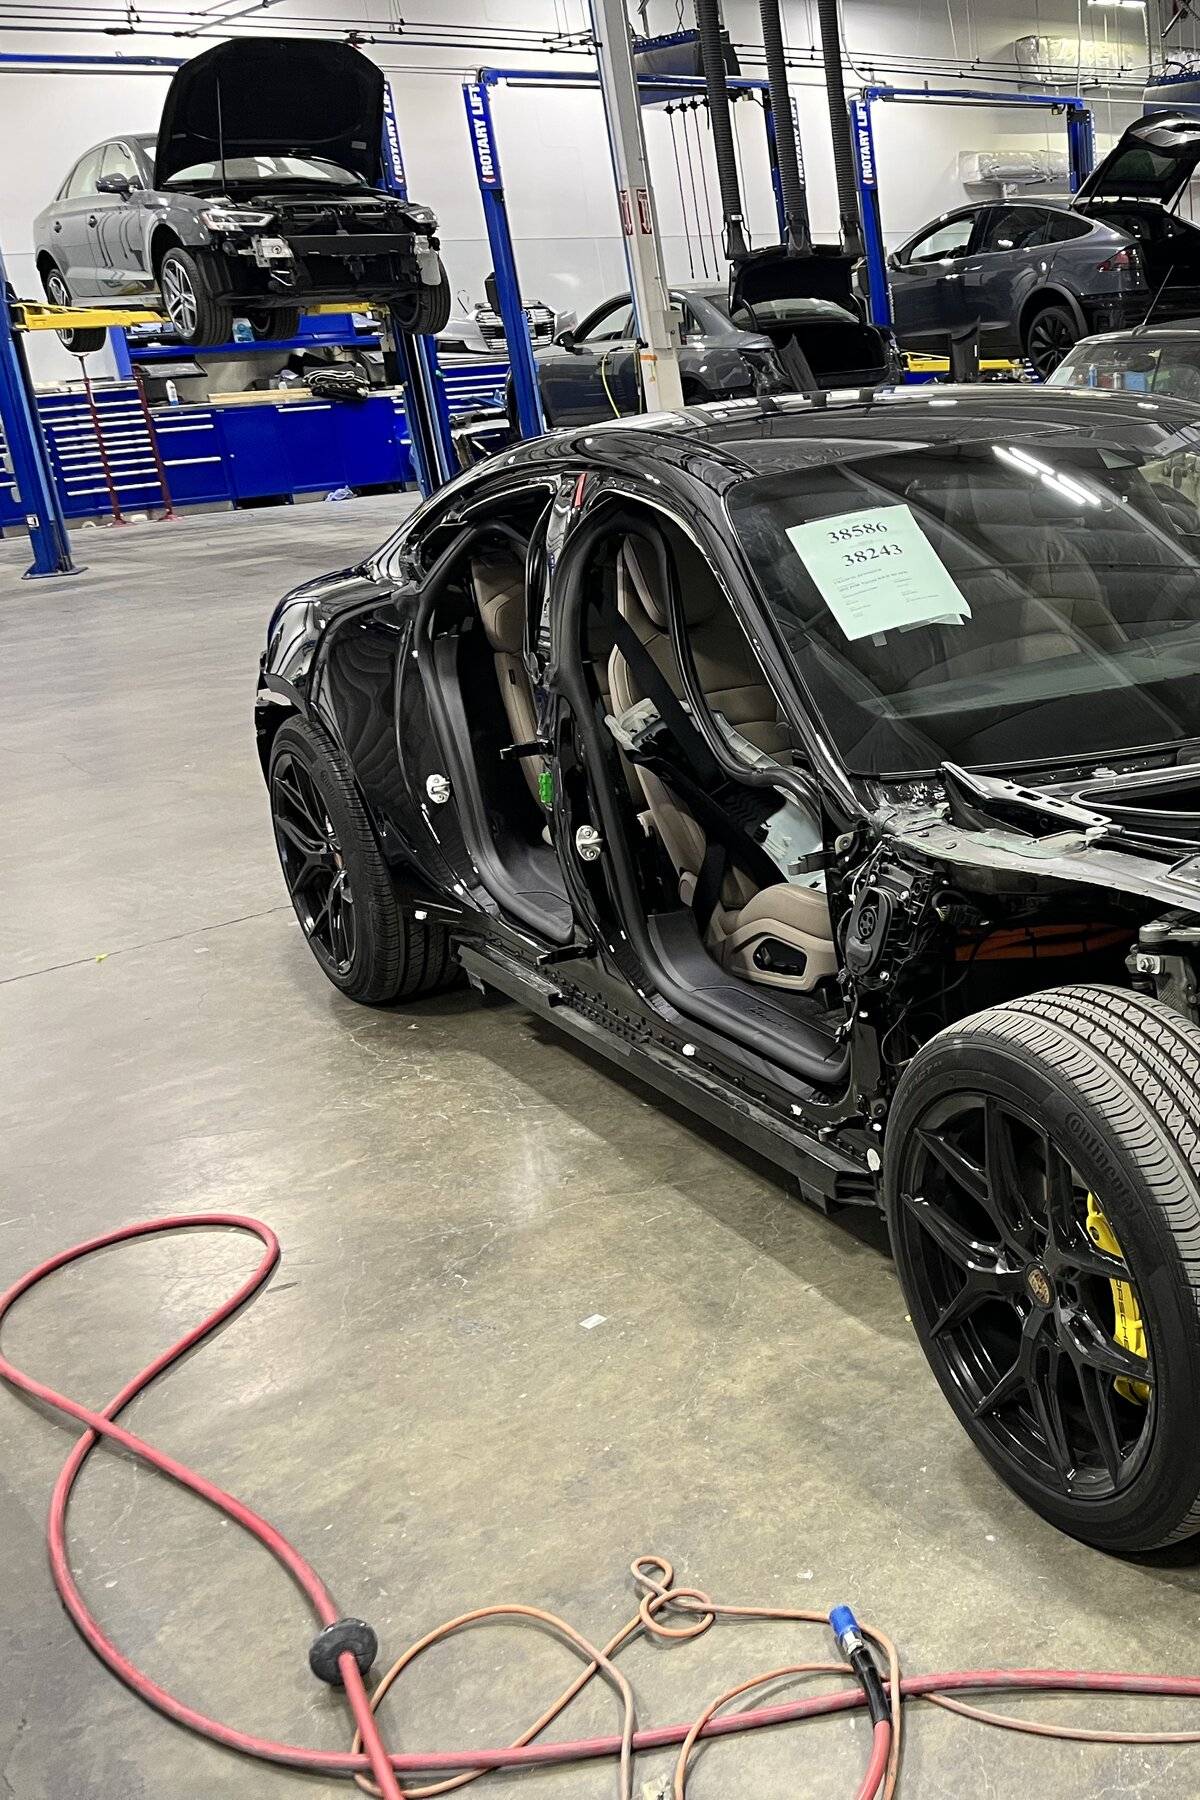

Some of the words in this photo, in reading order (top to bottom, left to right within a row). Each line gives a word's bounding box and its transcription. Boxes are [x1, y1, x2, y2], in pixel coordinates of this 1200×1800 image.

[468, 84, 484, 115] LIFT
[855, 100, 868, 127] LIFT
[386, 116, 402, 176] ROTARY
[473, 119, 494, 176] ROTARY
[858, 129, 873, 178] ROTARY
[827, 521, 889, 545] 38586
[841, 543, 904, 567] 38243
[1116, 1279, 1130, 1351] ORSCHE
